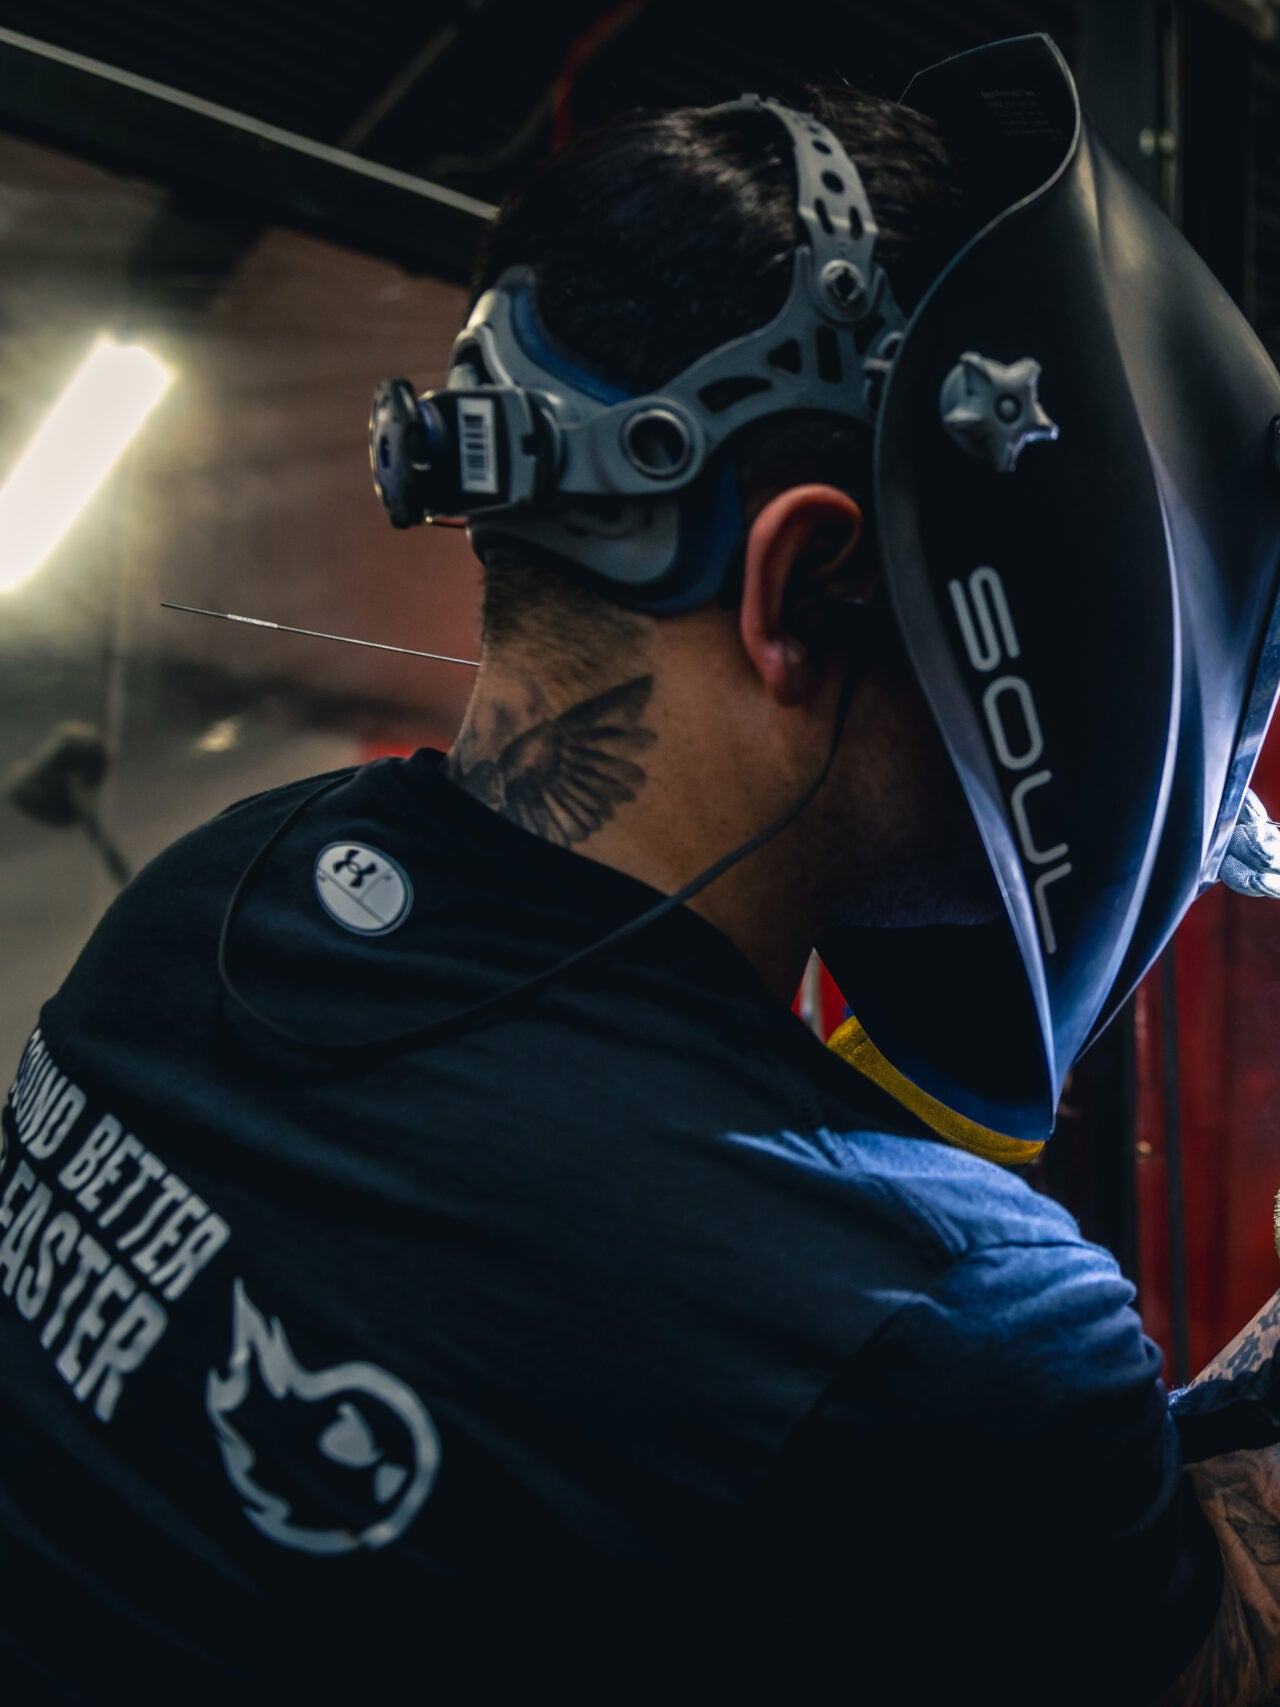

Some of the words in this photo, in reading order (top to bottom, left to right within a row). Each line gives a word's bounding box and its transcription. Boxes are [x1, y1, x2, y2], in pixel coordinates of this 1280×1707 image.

[948, 566, 1072, 955] SOUL
[0, 1159, 169, 1423] FASTER
[58, 1113, 231, 1302] BETTER
